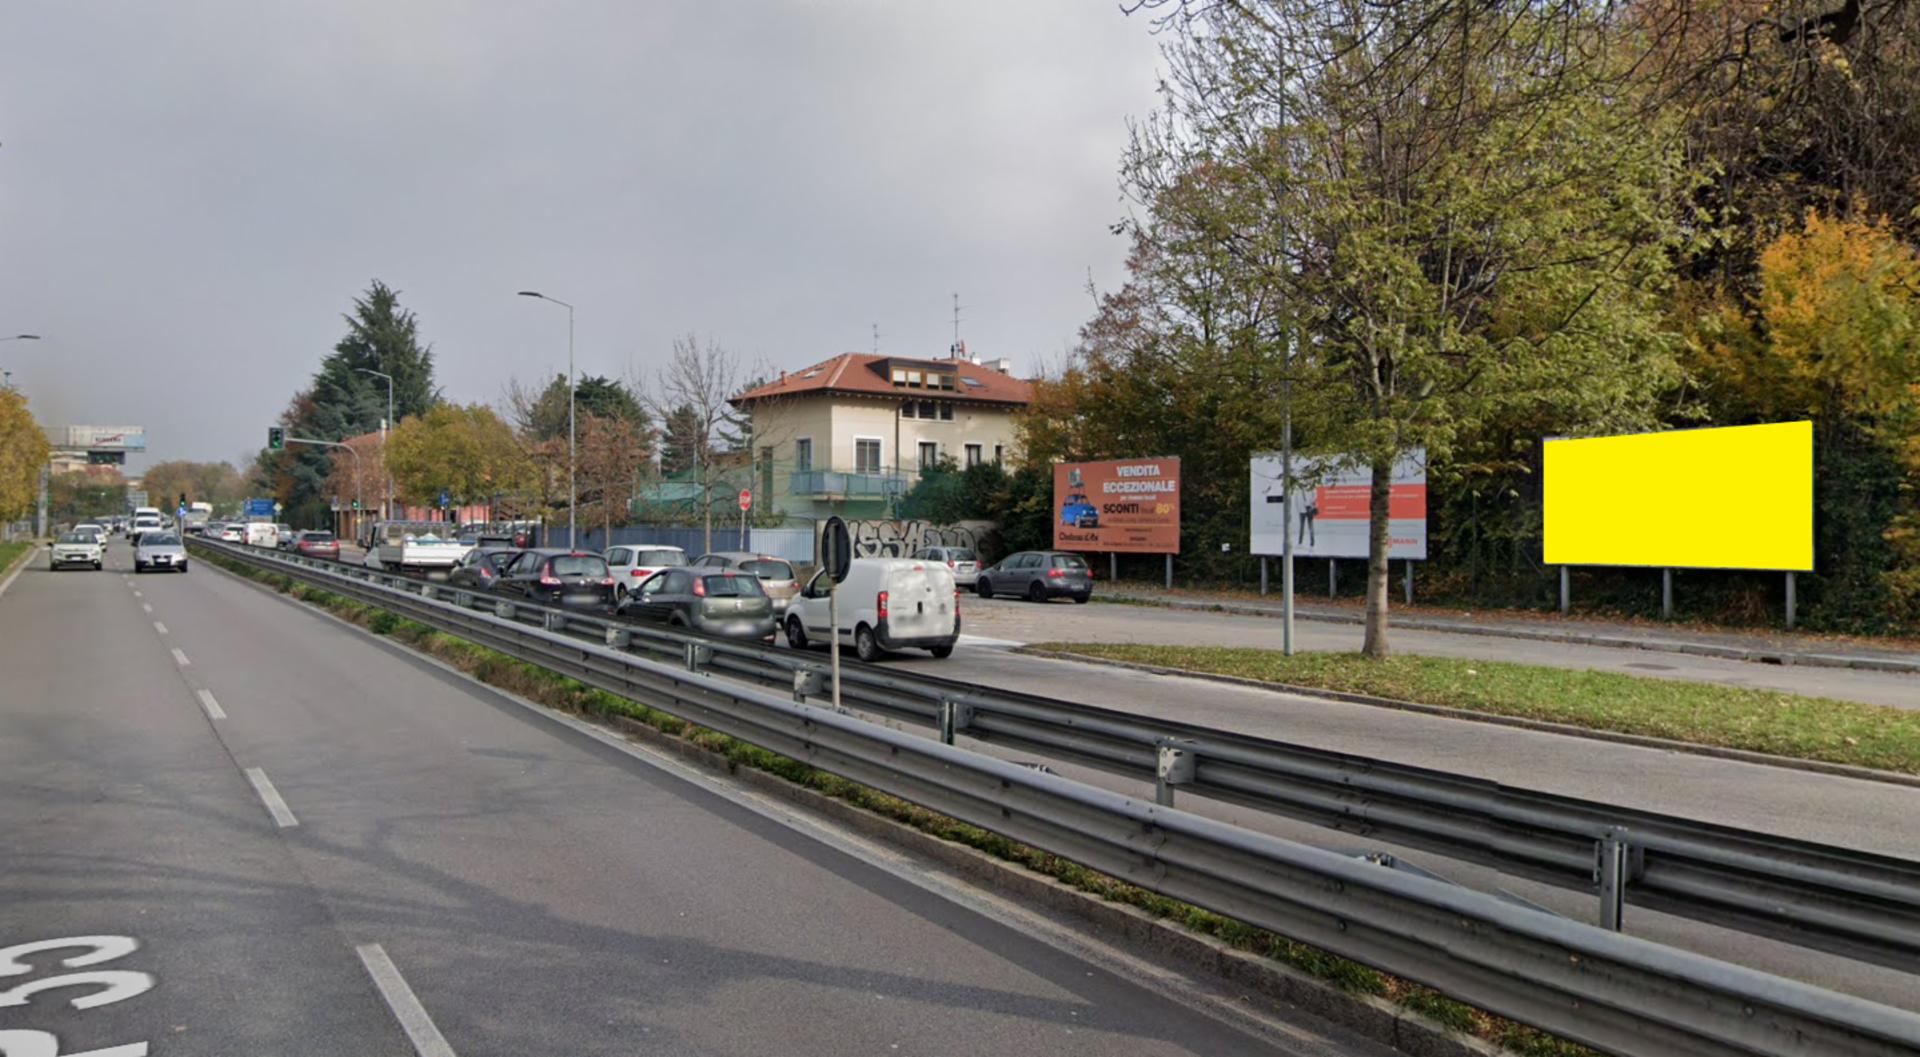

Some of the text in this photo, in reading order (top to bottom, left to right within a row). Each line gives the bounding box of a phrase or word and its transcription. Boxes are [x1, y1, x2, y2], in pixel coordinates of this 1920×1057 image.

[1116, 464, 1160, 477] VENDITA
[1103, 480, 1176, 493] ECCEZIONALE
[1103, 503, 1139, 514] SCONTI
